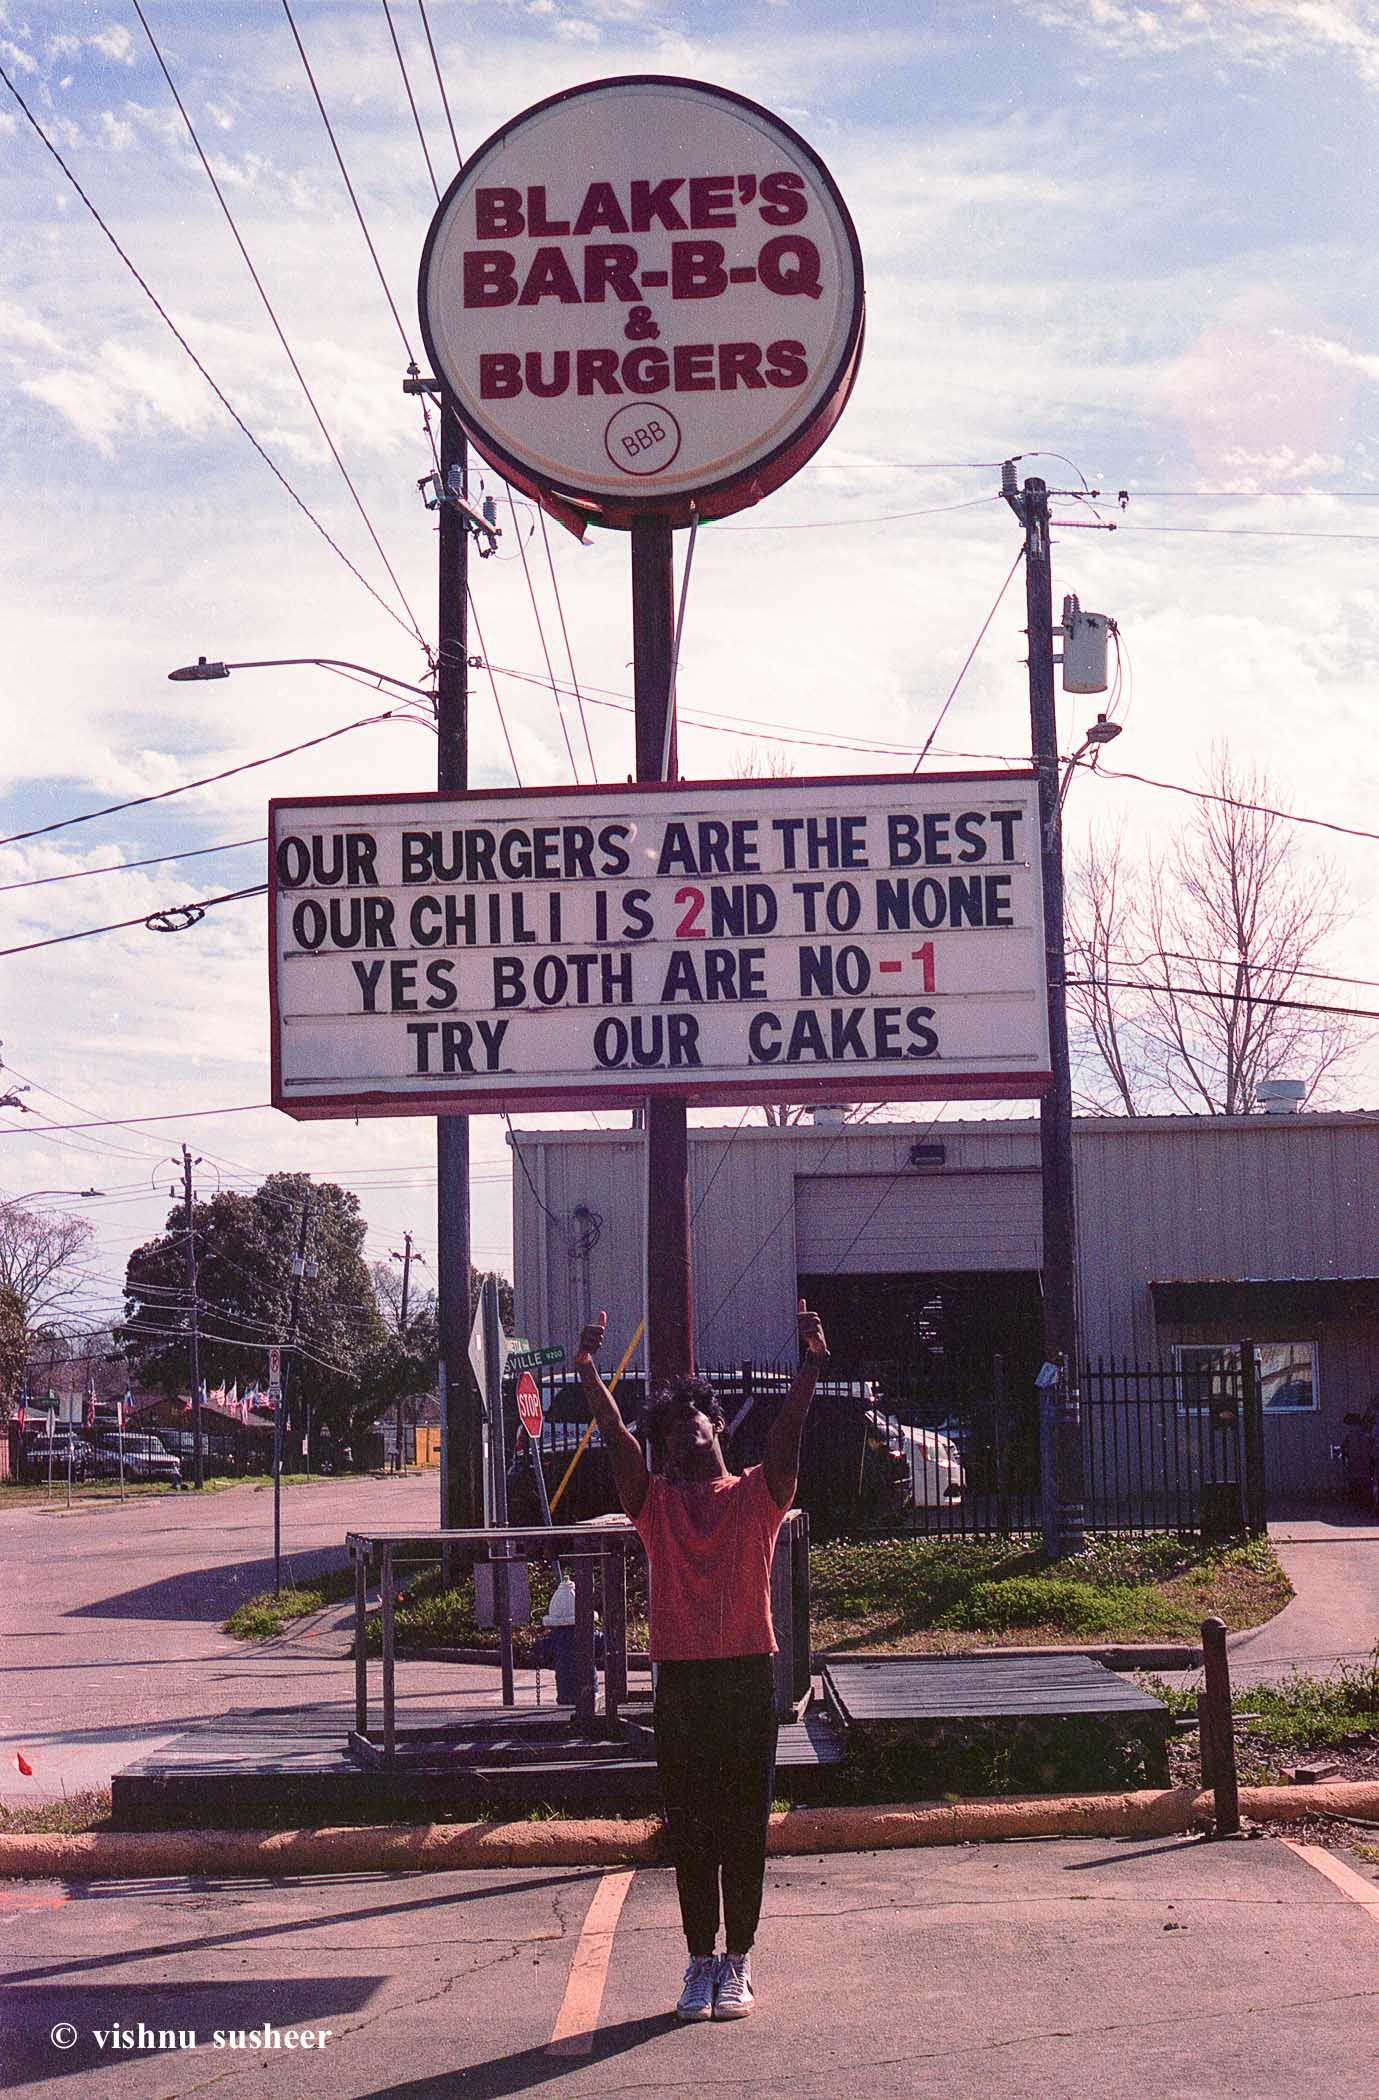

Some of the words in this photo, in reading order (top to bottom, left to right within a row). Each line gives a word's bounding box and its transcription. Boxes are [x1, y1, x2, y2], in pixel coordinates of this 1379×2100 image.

[475, 171, 808, 240] BLAKE'S
[463, 234, 824, 309] BAR-B-Q
[623, 306, 661, 340] &
[479, 339, 808, 400] BURGERS
[621, 421, 666, 457] BBB
[277, 832, 378, 887] OUR
[402, 825, 631, 883] BURGERS
[656, 819, 761, 875] ARE
[772, 815, 869, 869] THE
[887, 810, 1023, 866] BEST
[293, 896, 396, 950] OUR
[410, 891, 562, 946] CHILI
[595, 889, 654, 942] IS
[673, 882, 777, 938] 2ND
[792, 880, 861, 932] TO
[876, 874, 1014, 930] NONE
[351, 959, 458, 1012] YES
[493, 952, 633, 1008] BOTH
[660, 947, 768, 1001] ARE
[799, 941, 936, 997] NO-1
[406, 1019, 510, 1073] TRY
[593, 1013, 701, 1068] OUR
[748, 1006, 939, 1061] CAKES
[519, 1393, 539, 1417] STOP
